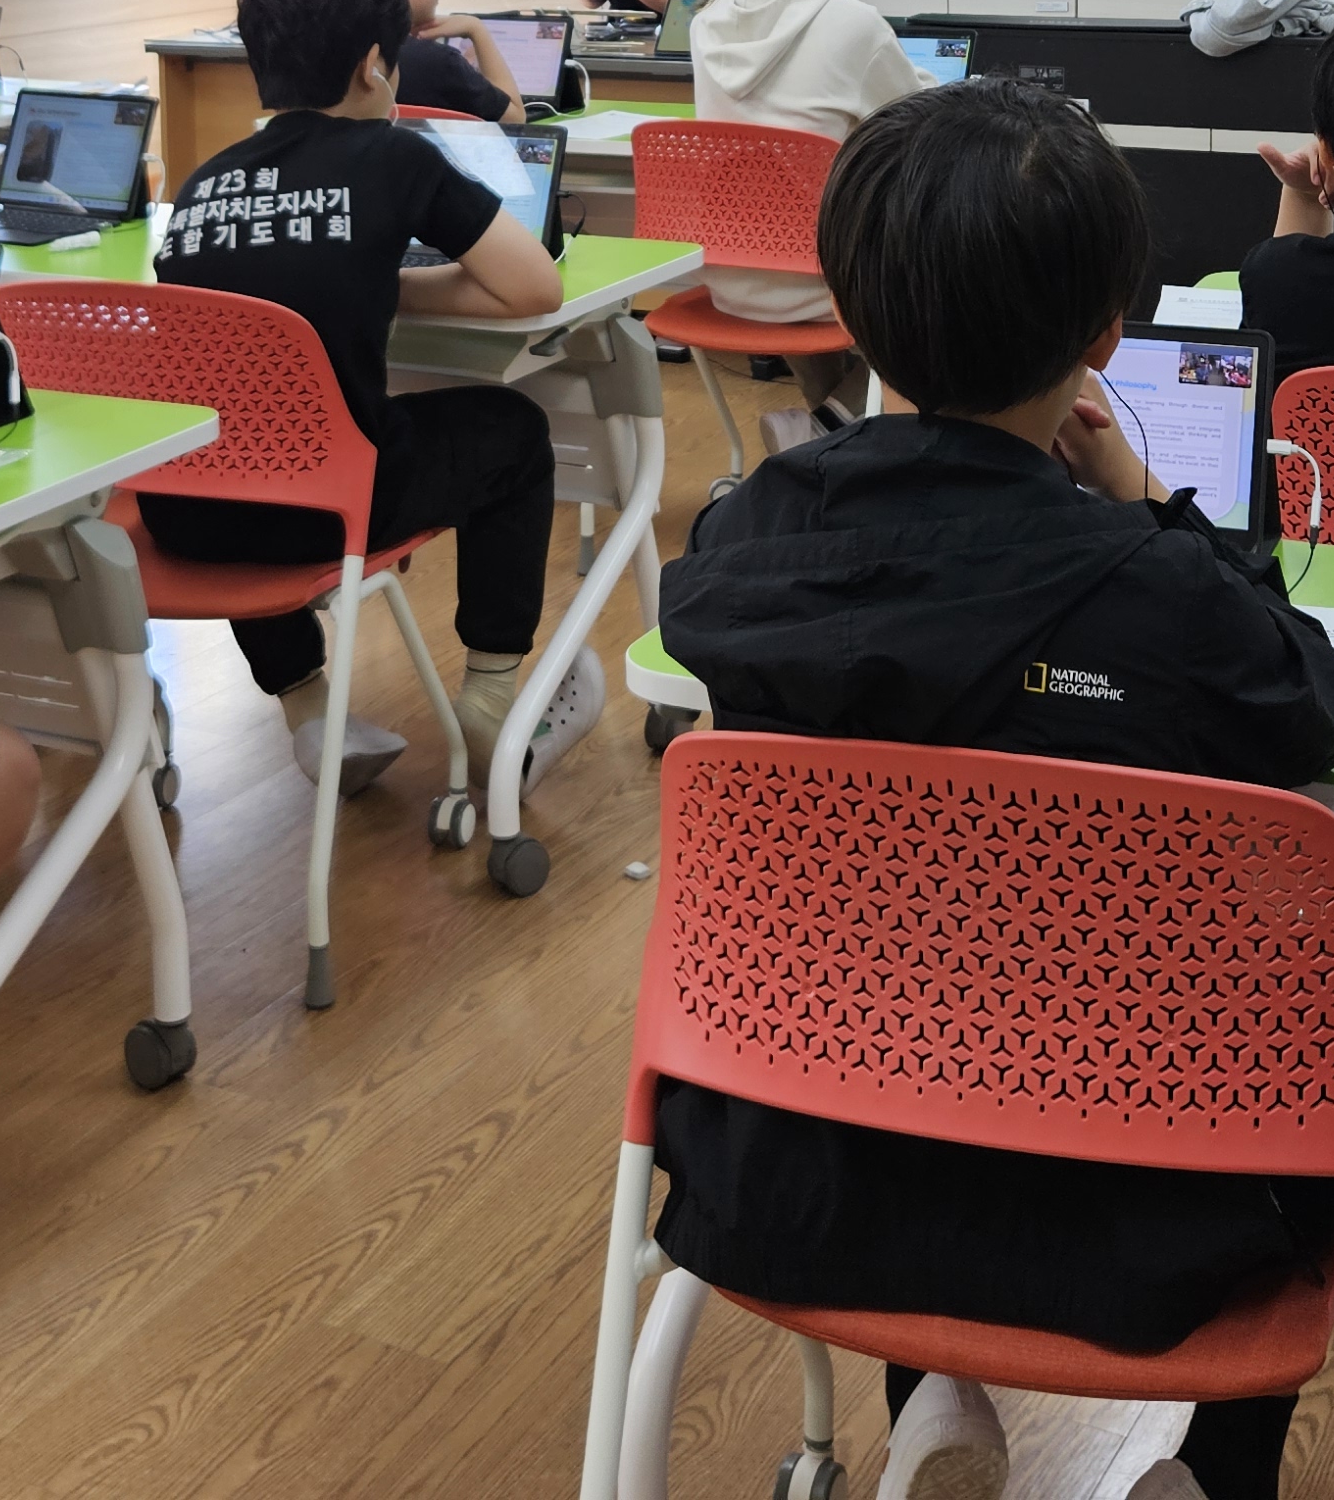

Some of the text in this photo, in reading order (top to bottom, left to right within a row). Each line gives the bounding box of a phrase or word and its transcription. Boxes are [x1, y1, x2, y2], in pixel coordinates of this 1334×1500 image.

[167, 187, 351, 234] 특별자치도지사기
[1115, 379, 1157, 391] Philosophy
[1051, 667, 1111, 687] NATIONAL
[1049, 681, 1125, 702] GEOGRAPHIC
